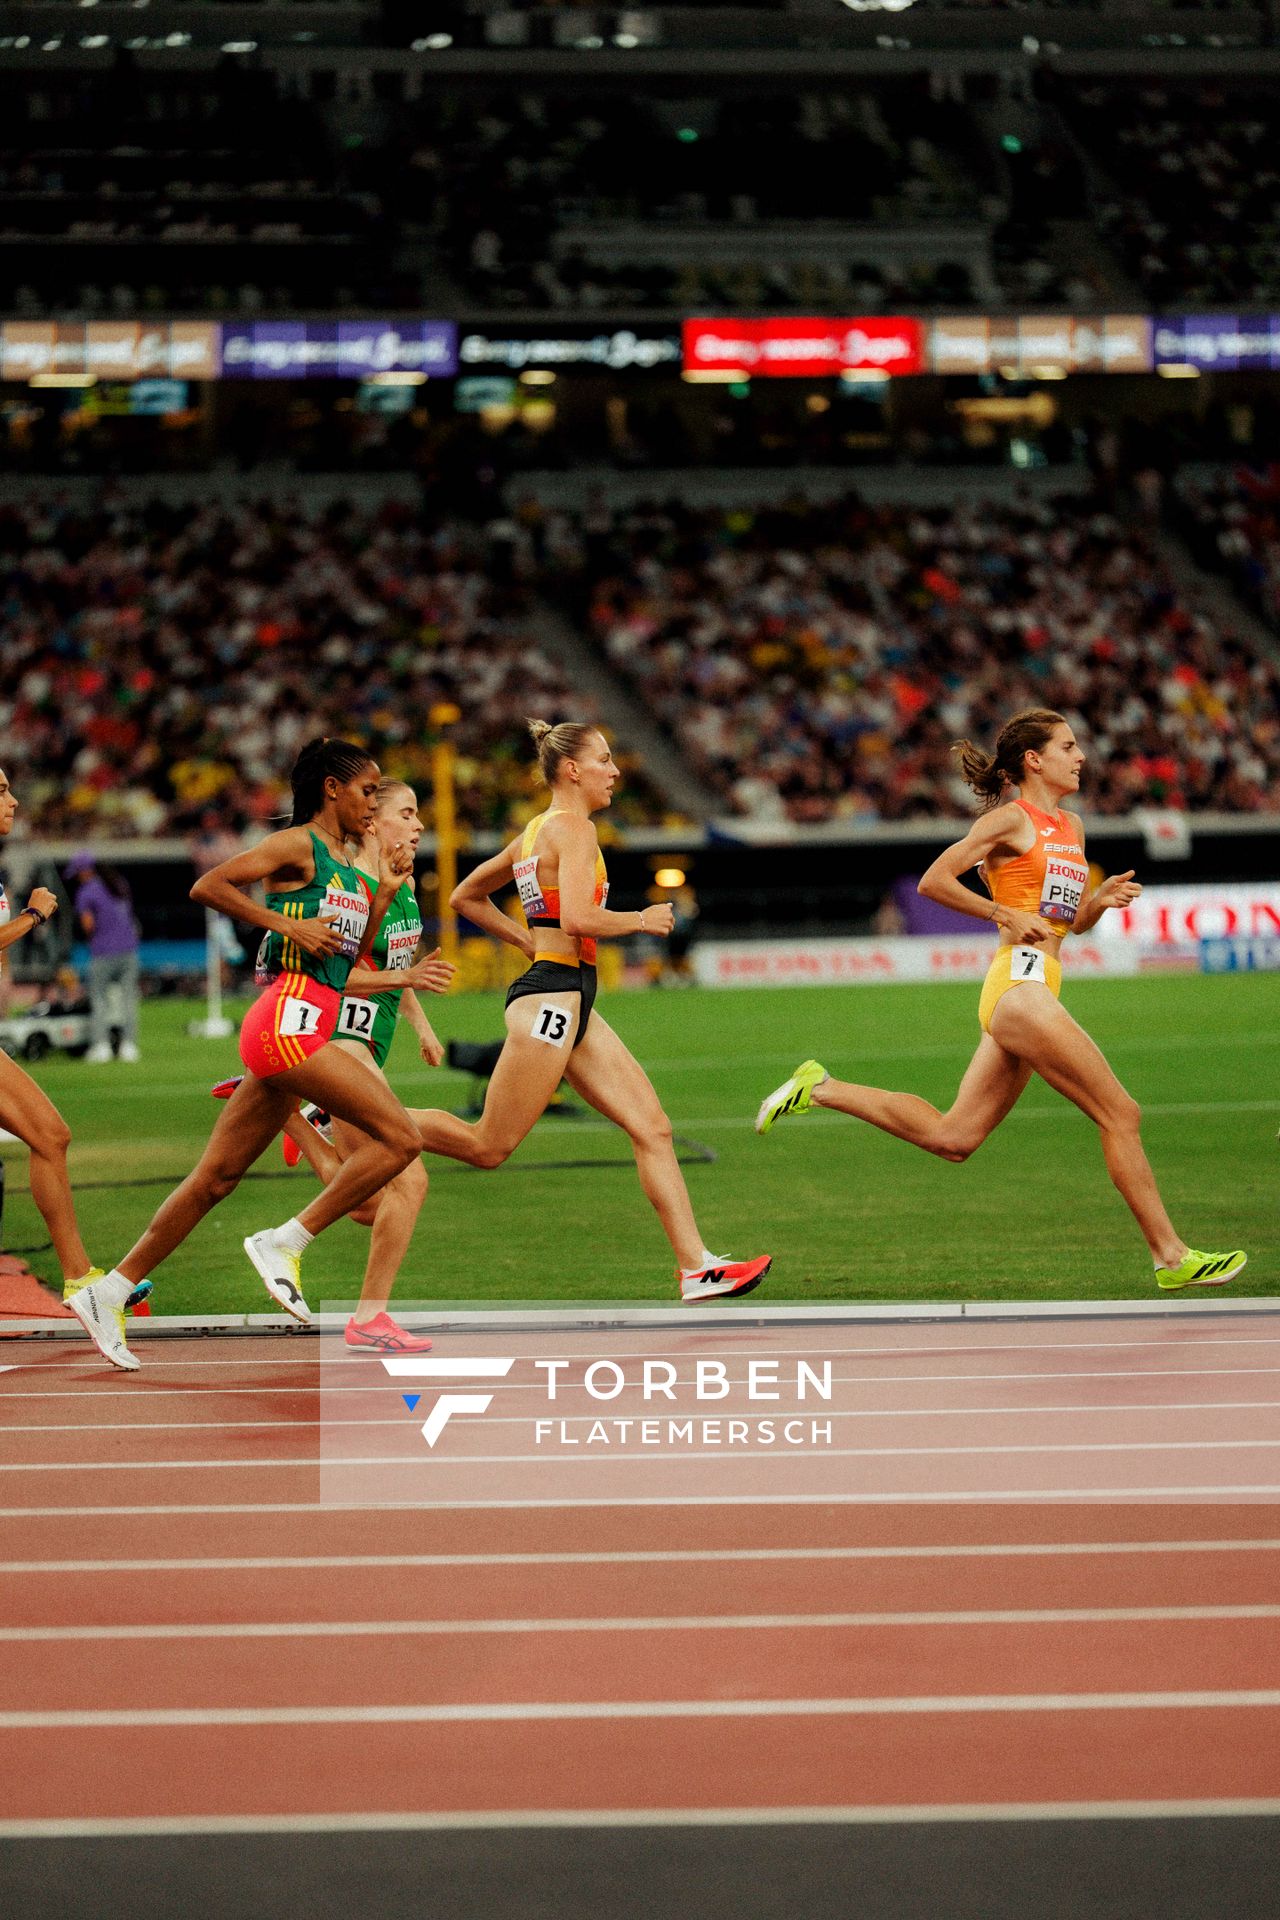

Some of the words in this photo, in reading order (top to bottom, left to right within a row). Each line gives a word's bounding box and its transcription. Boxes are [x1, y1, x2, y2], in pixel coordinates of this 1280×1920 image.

[1043, 843, 1082, 855] ESPAÑ
[1048, 863, 1087, 883] HOND
[327, 894, 369, 916] HONDA
[1049, 883, 1080, 907] PÉRE
[390, 934, 420, 950] HOND
[1021, 951, 1038, 976] 7
[298, 1006, 309, 1032] 1
[346, 1003, 371, 1035] 12
[540, 1009, 567, 1040] 13
